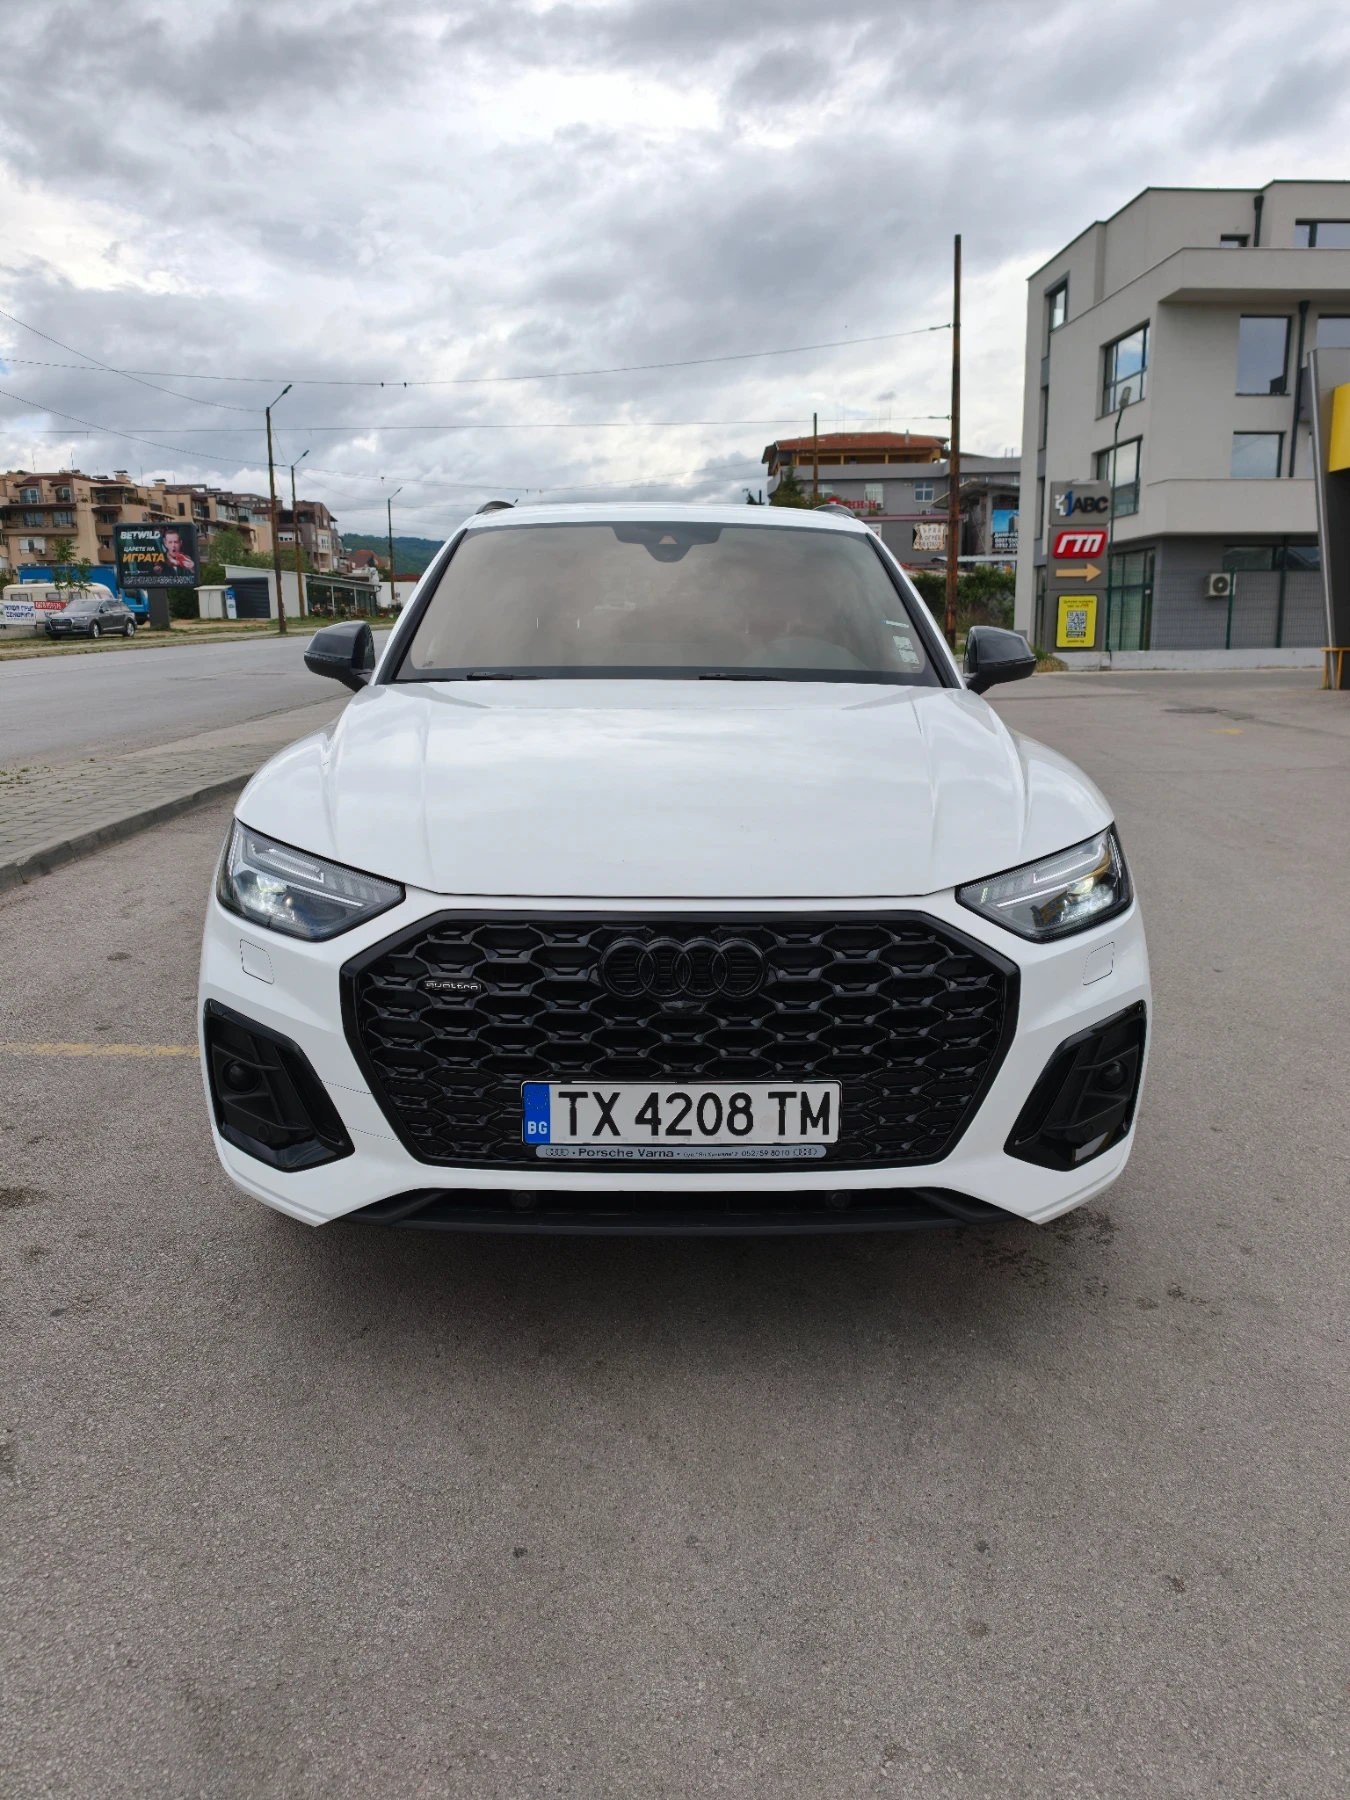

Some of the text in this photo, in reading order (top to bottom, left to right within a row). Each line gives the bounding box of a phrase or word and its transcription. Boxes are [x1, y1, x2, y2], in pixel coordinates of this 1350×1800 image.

[1057, 534, 1103, 553] ГТП
[122, 553, 166, 563] ИГРАТА
[426, 982, 479, 990] quattro
[558, 1090, 831, 1137] TX 4208 TM
[527, 1121, 548, 1135] BG
[578, 1148, 634, 1158] Porsche
[638, 1148, 674, 1158] Varna
